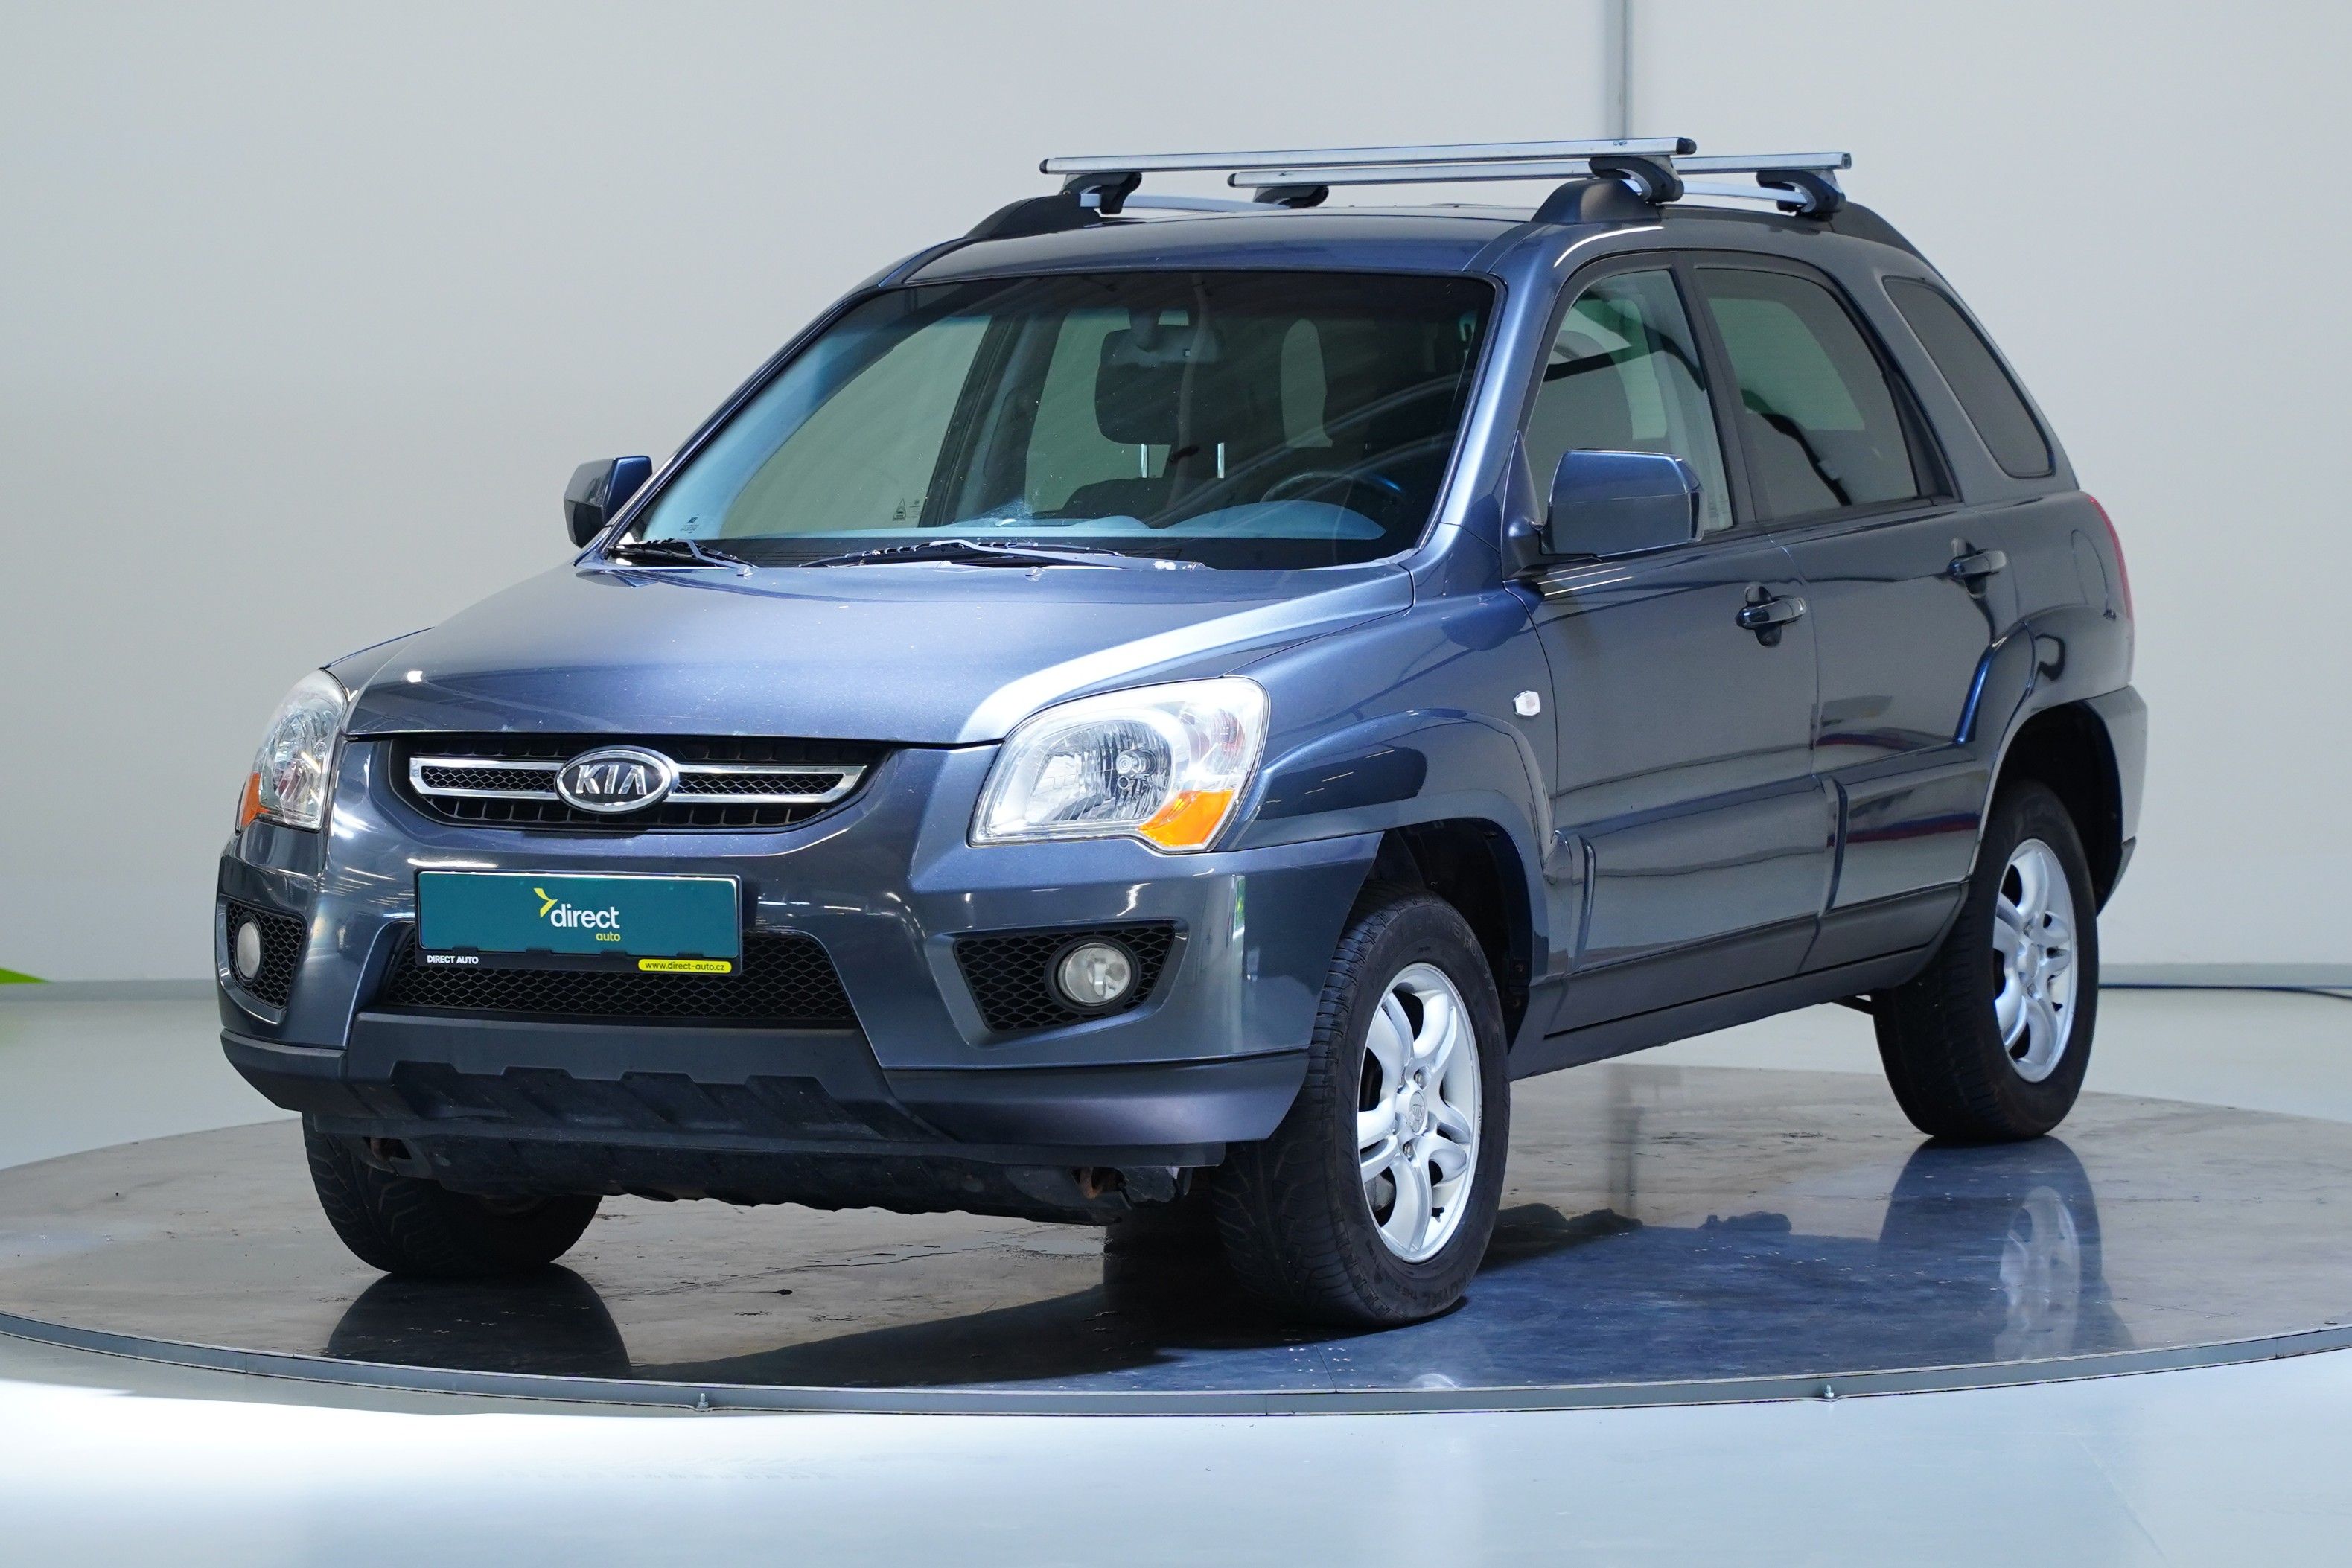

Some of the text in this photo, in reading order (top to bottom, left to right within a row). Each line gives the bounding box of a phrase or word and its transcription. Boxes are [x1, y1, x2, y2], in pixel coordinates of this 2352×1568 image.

[576, 765, 647, 795] KIA
[550, 903, 620, 929] direct
[596, 931, 621, 942] auto
[427, 954, 479, 965] DIRECT AUTO
[645, 961, 724, 971] www.direct-auto.cz
